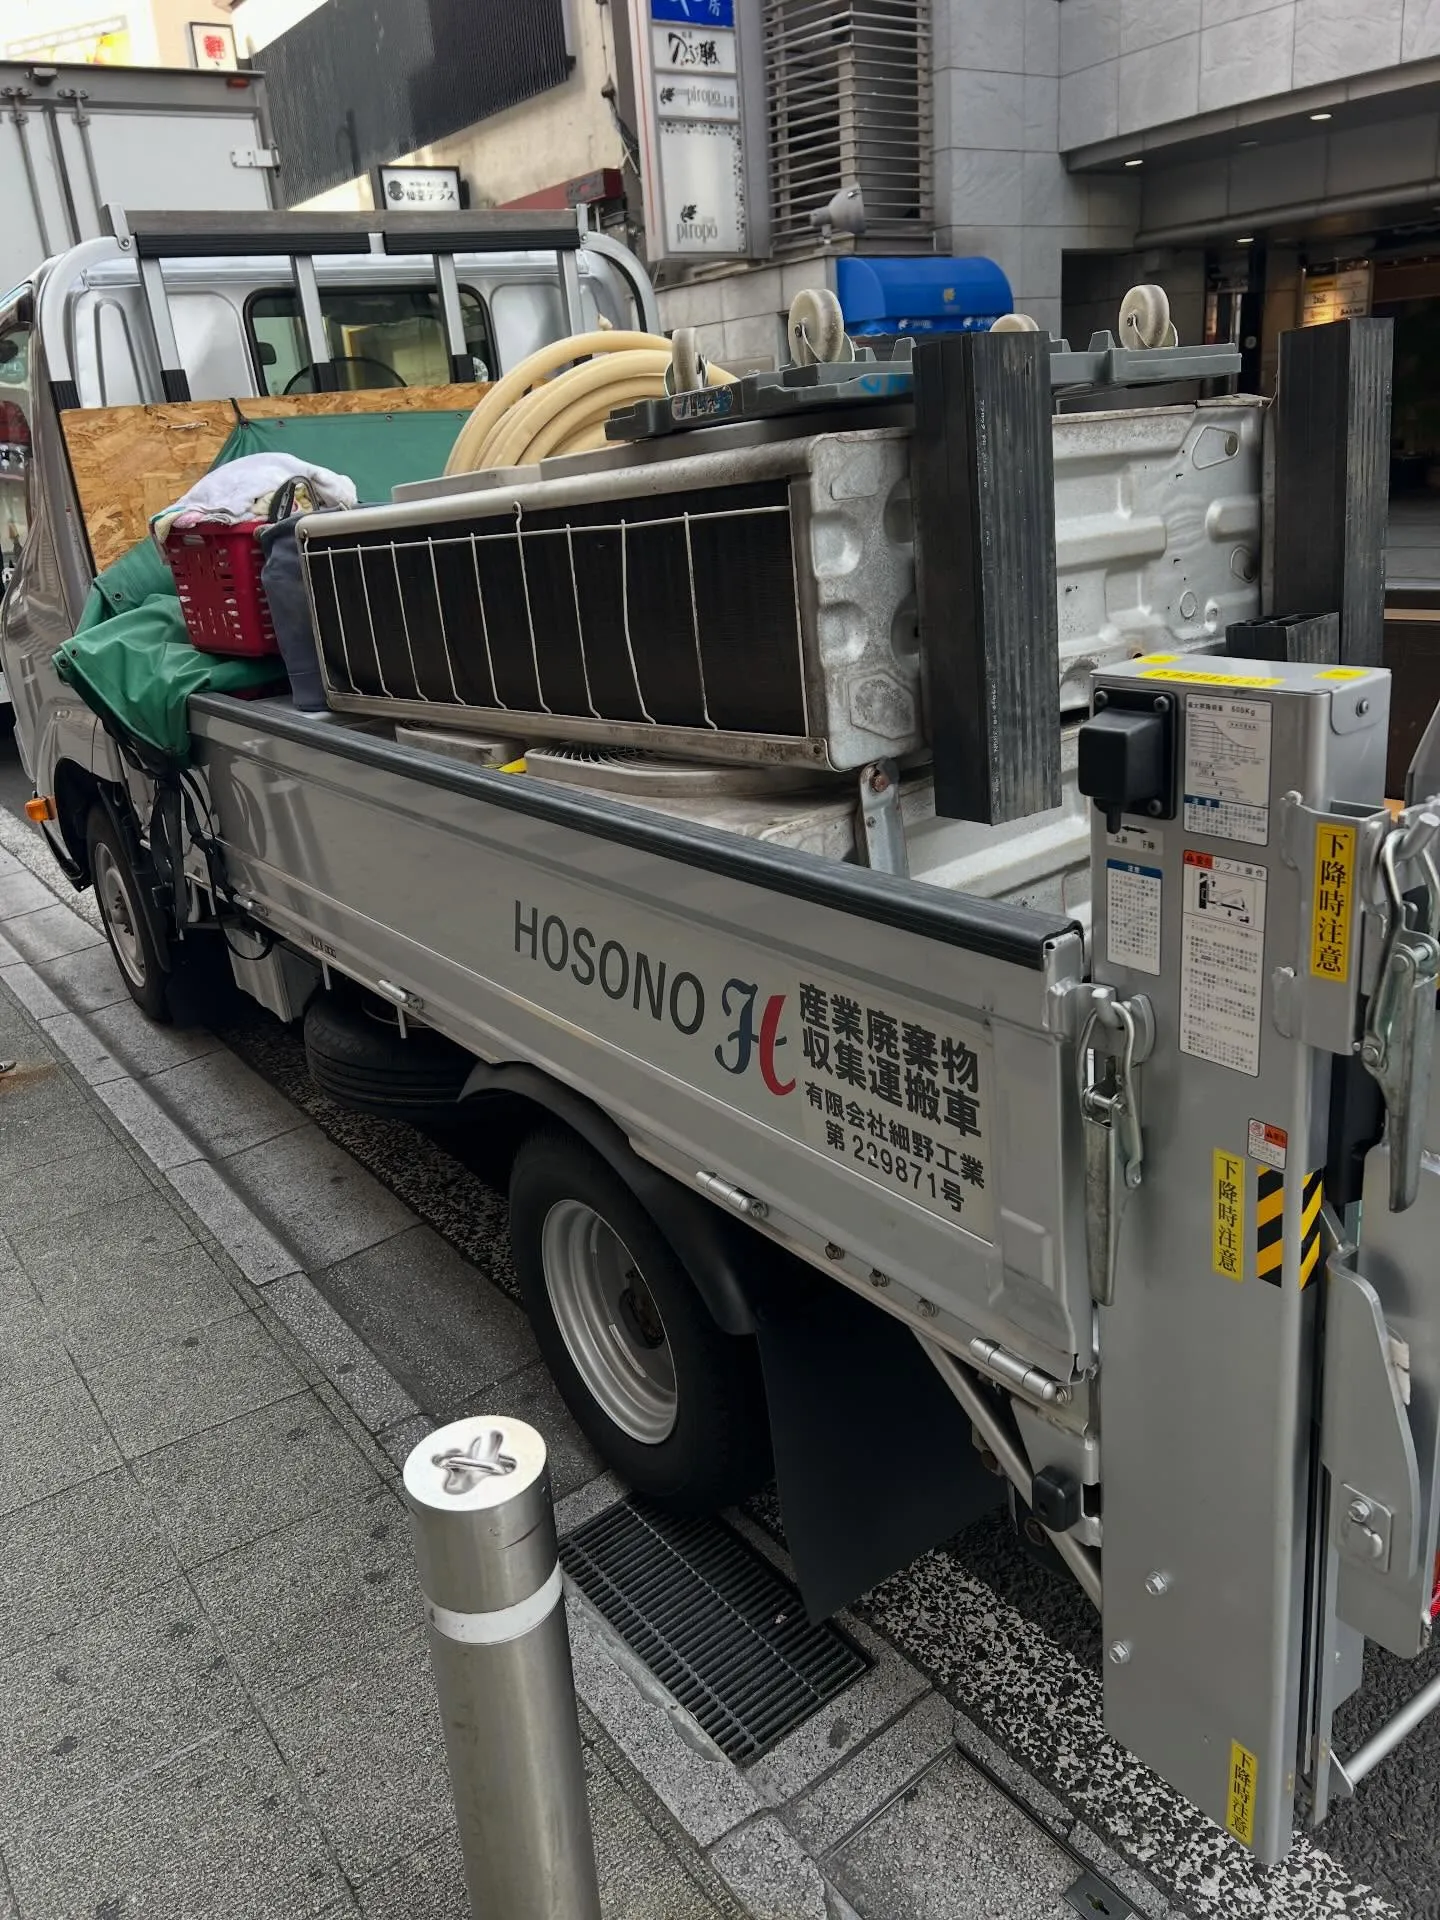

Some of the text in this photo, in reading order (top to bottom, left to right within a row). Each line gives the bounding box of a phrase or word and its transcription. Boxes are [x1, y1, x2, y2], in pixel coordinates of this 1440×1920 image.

[687, 86, 720, 106] piropo
[676, 222, 718, 244] piropo
[1316, 832, 1349, 973] 下降時注意
[514, 899, 706, 1036] HOSONO
[800, 983, 980, 1094] 産業廃棄物
[803, 1026, 982, 1138] 収集運搬車
[805, 1081, 985, 1190] 有限会社細野工業
[1217, 1156, 1239, 1274] 下降時注意
[1230, 1746, 1253, 1838] 下降時注意
